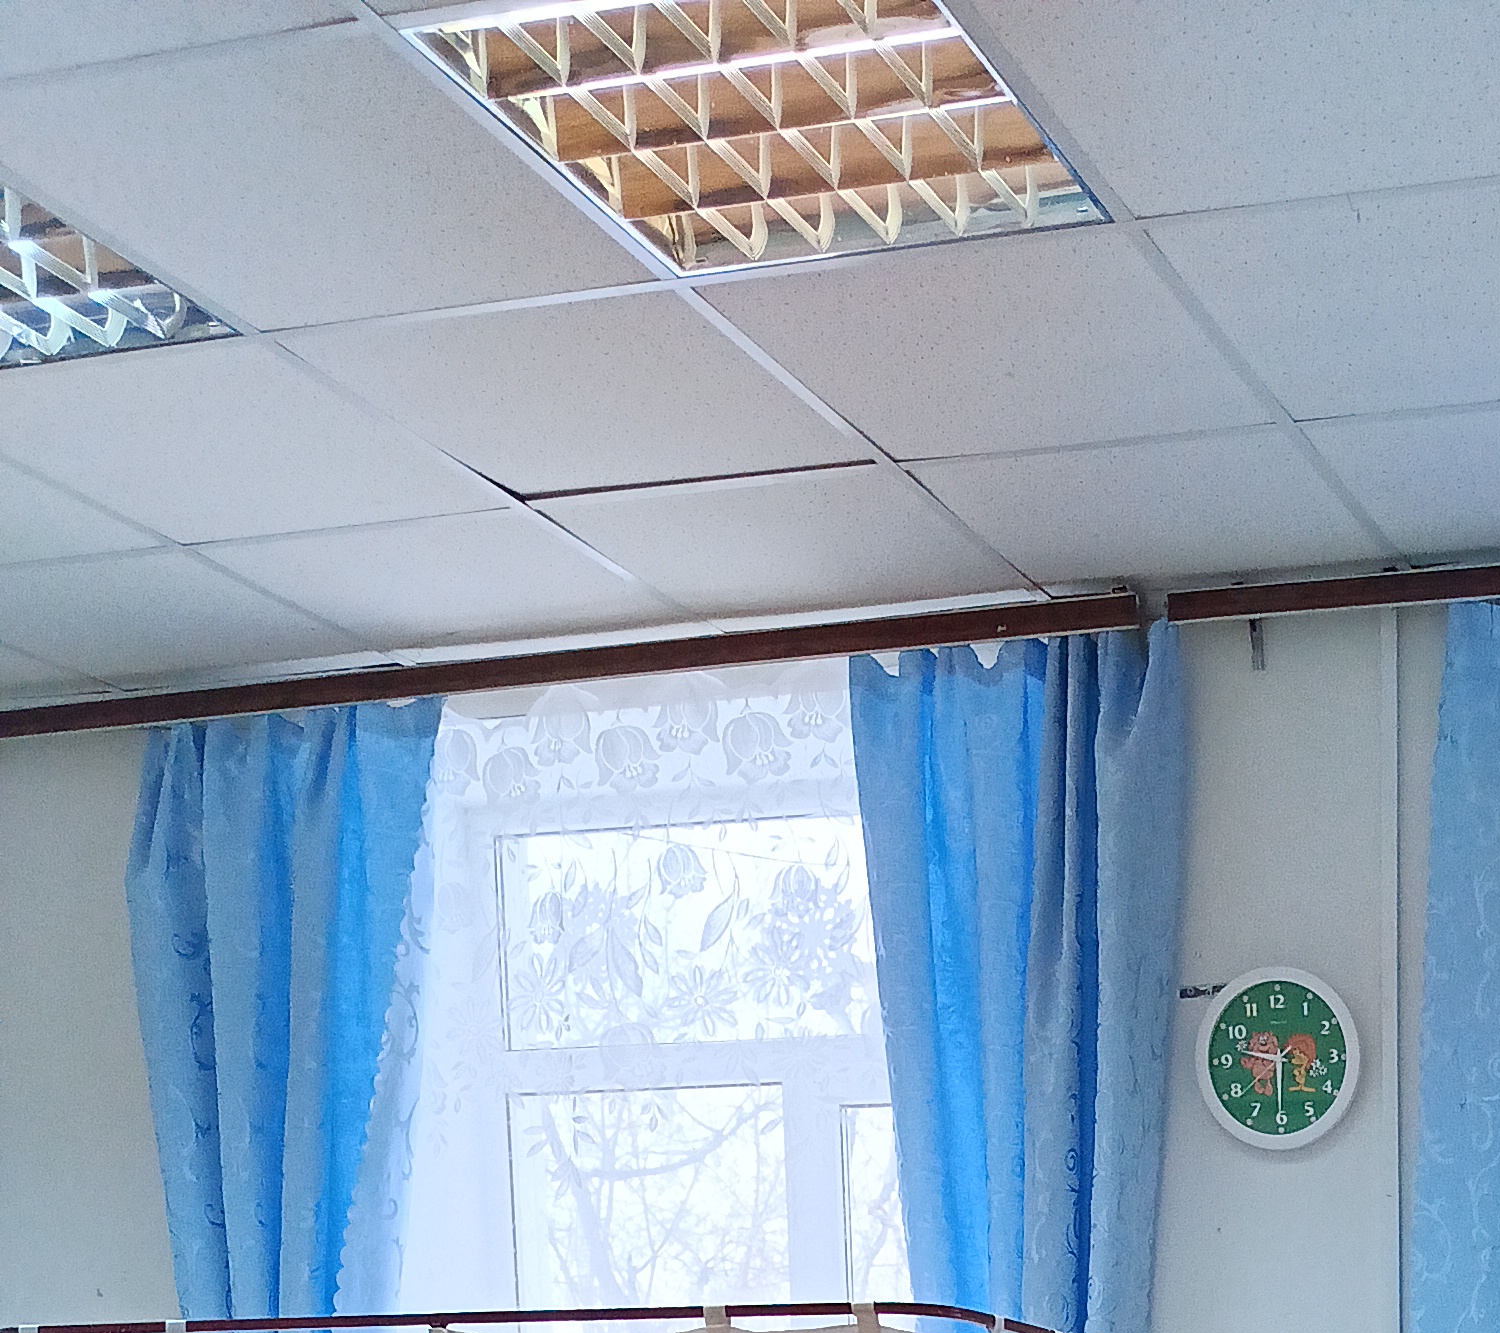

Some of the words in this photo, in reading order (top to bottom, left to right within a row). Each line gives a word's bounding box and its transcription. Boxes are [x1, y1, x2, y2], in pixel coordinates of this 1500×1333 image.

[1269, 994, 1286, 1009] 12
[1302, 1001, 1309, 1016] 1
[1245, 1003, 1257, 1017] 11
[1228, 1024, 1247, 1040] 10
[1320, 1020, 1331, 1035] 2
[1220, 1053, 1233, 1069] 9
[1328, 1048, 1339, 1064] 3
[1230, 1082, 1242, 1098] 8
[1321, 1079, 1333, 1094] 4
[1249, 1102, 1261, 1117] 7
[1304, 1101, 1315, 1117] 5
[1275, 1110, 1288, 1125] 6
